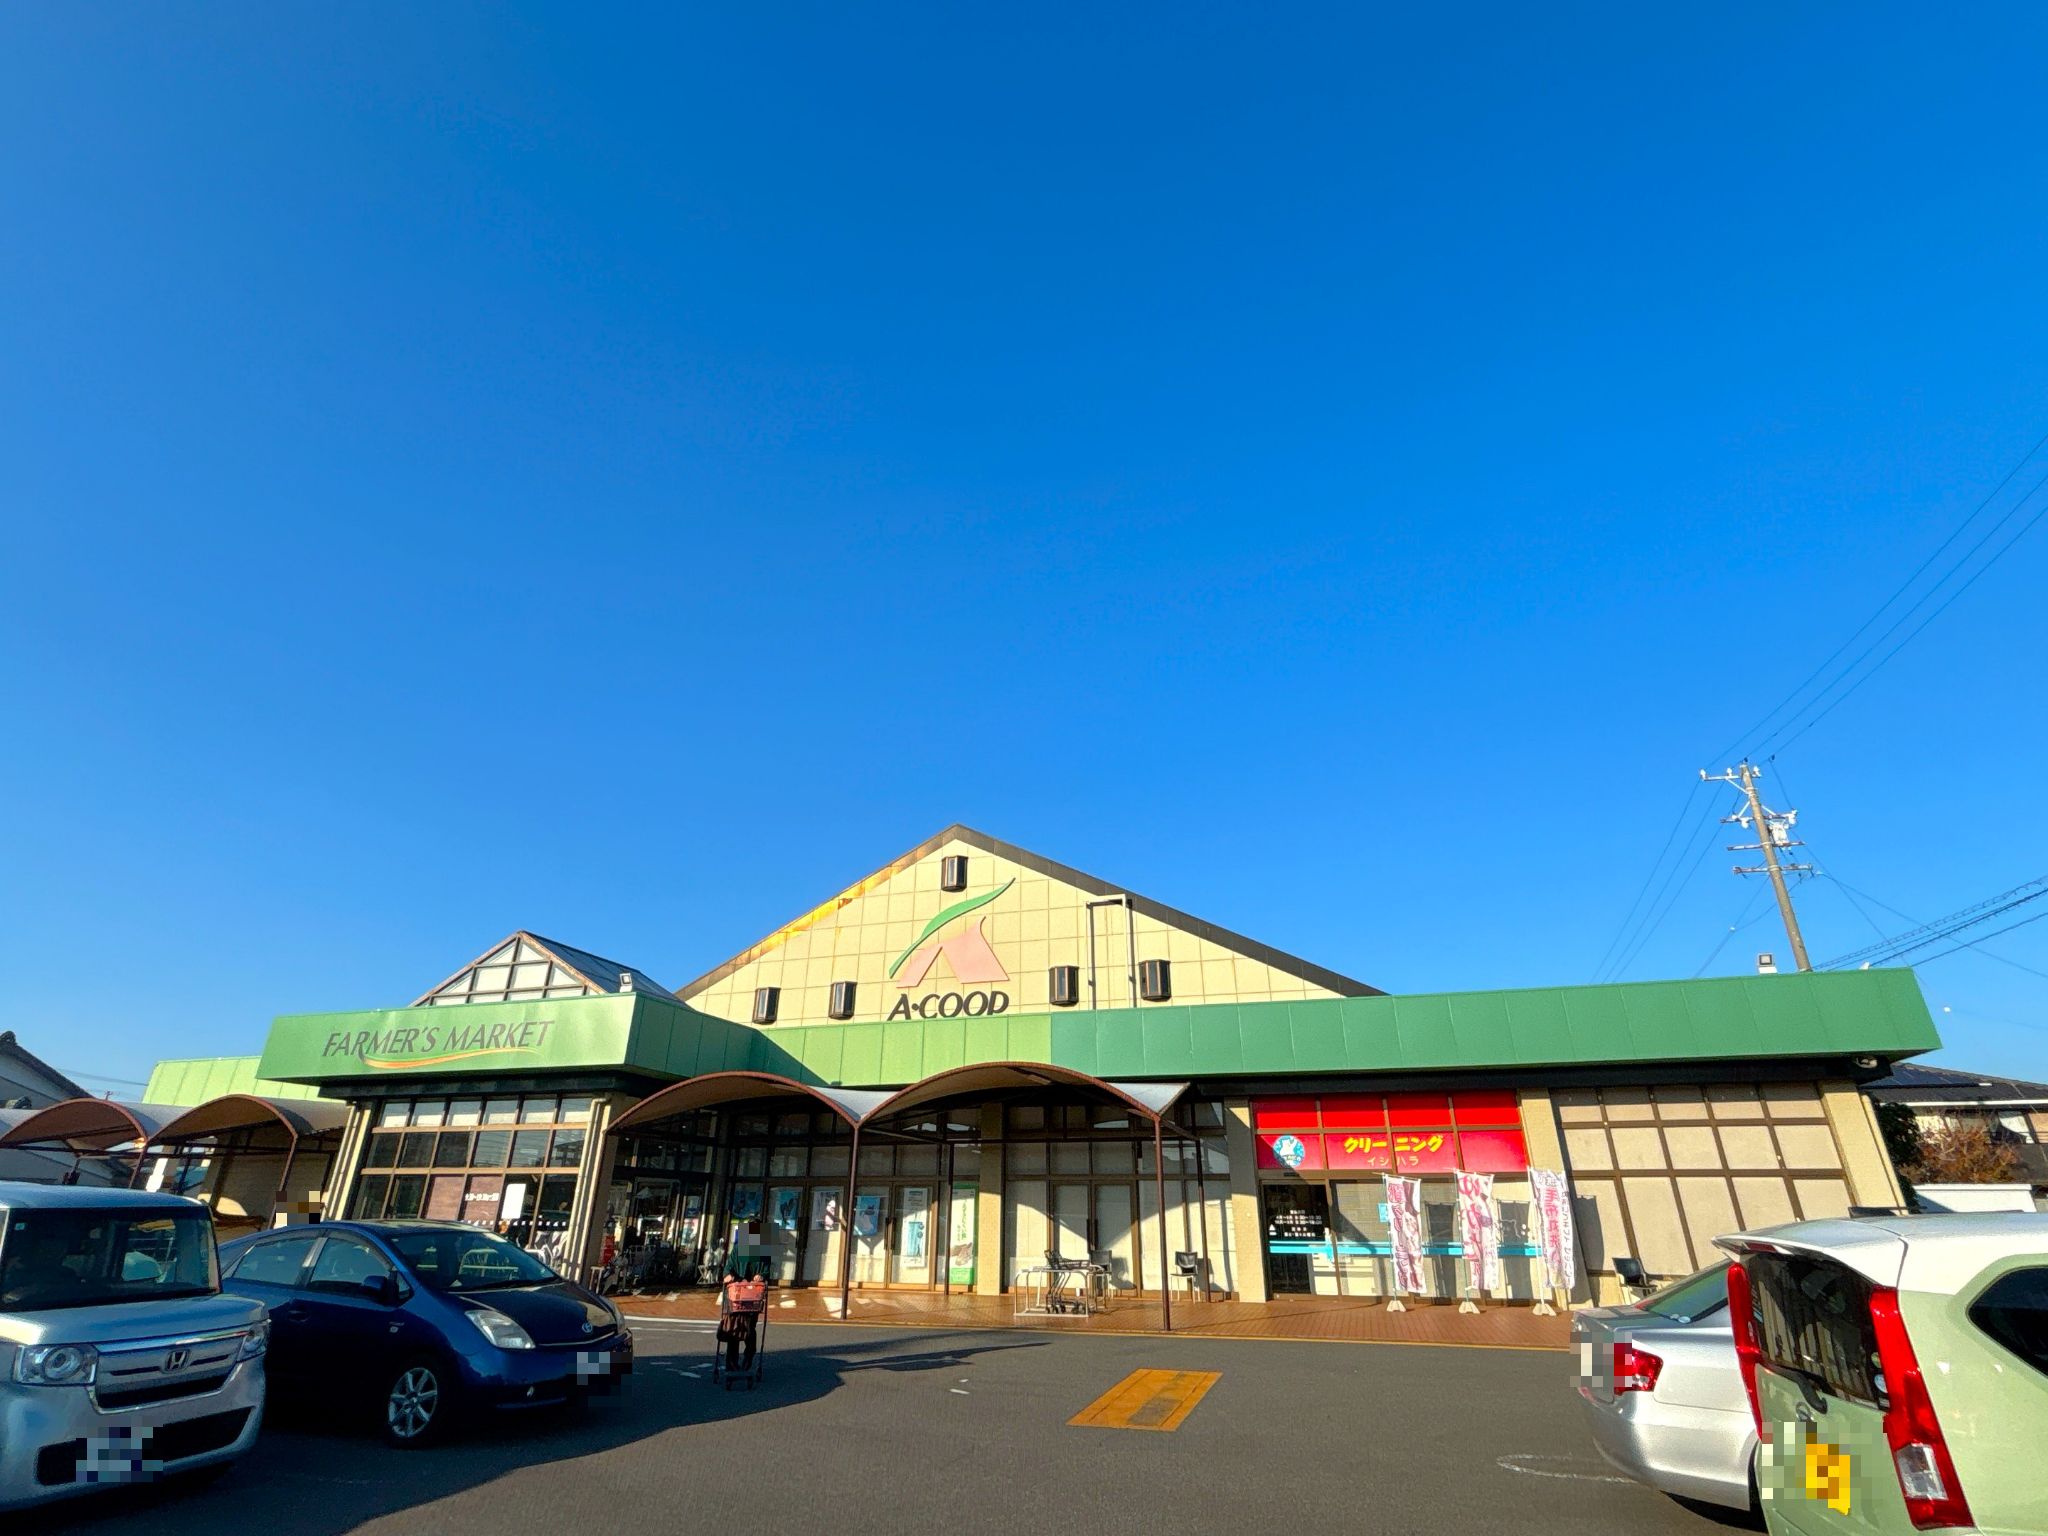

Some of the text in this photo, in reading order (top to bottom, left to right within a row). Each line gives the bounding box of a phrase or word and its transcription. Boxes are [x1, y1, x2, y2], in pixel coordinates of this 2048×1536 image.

[322, 1020, 555, 1062] FARMER'S MARKET
[1344, 1135, 1443, 1153] クリーニング
